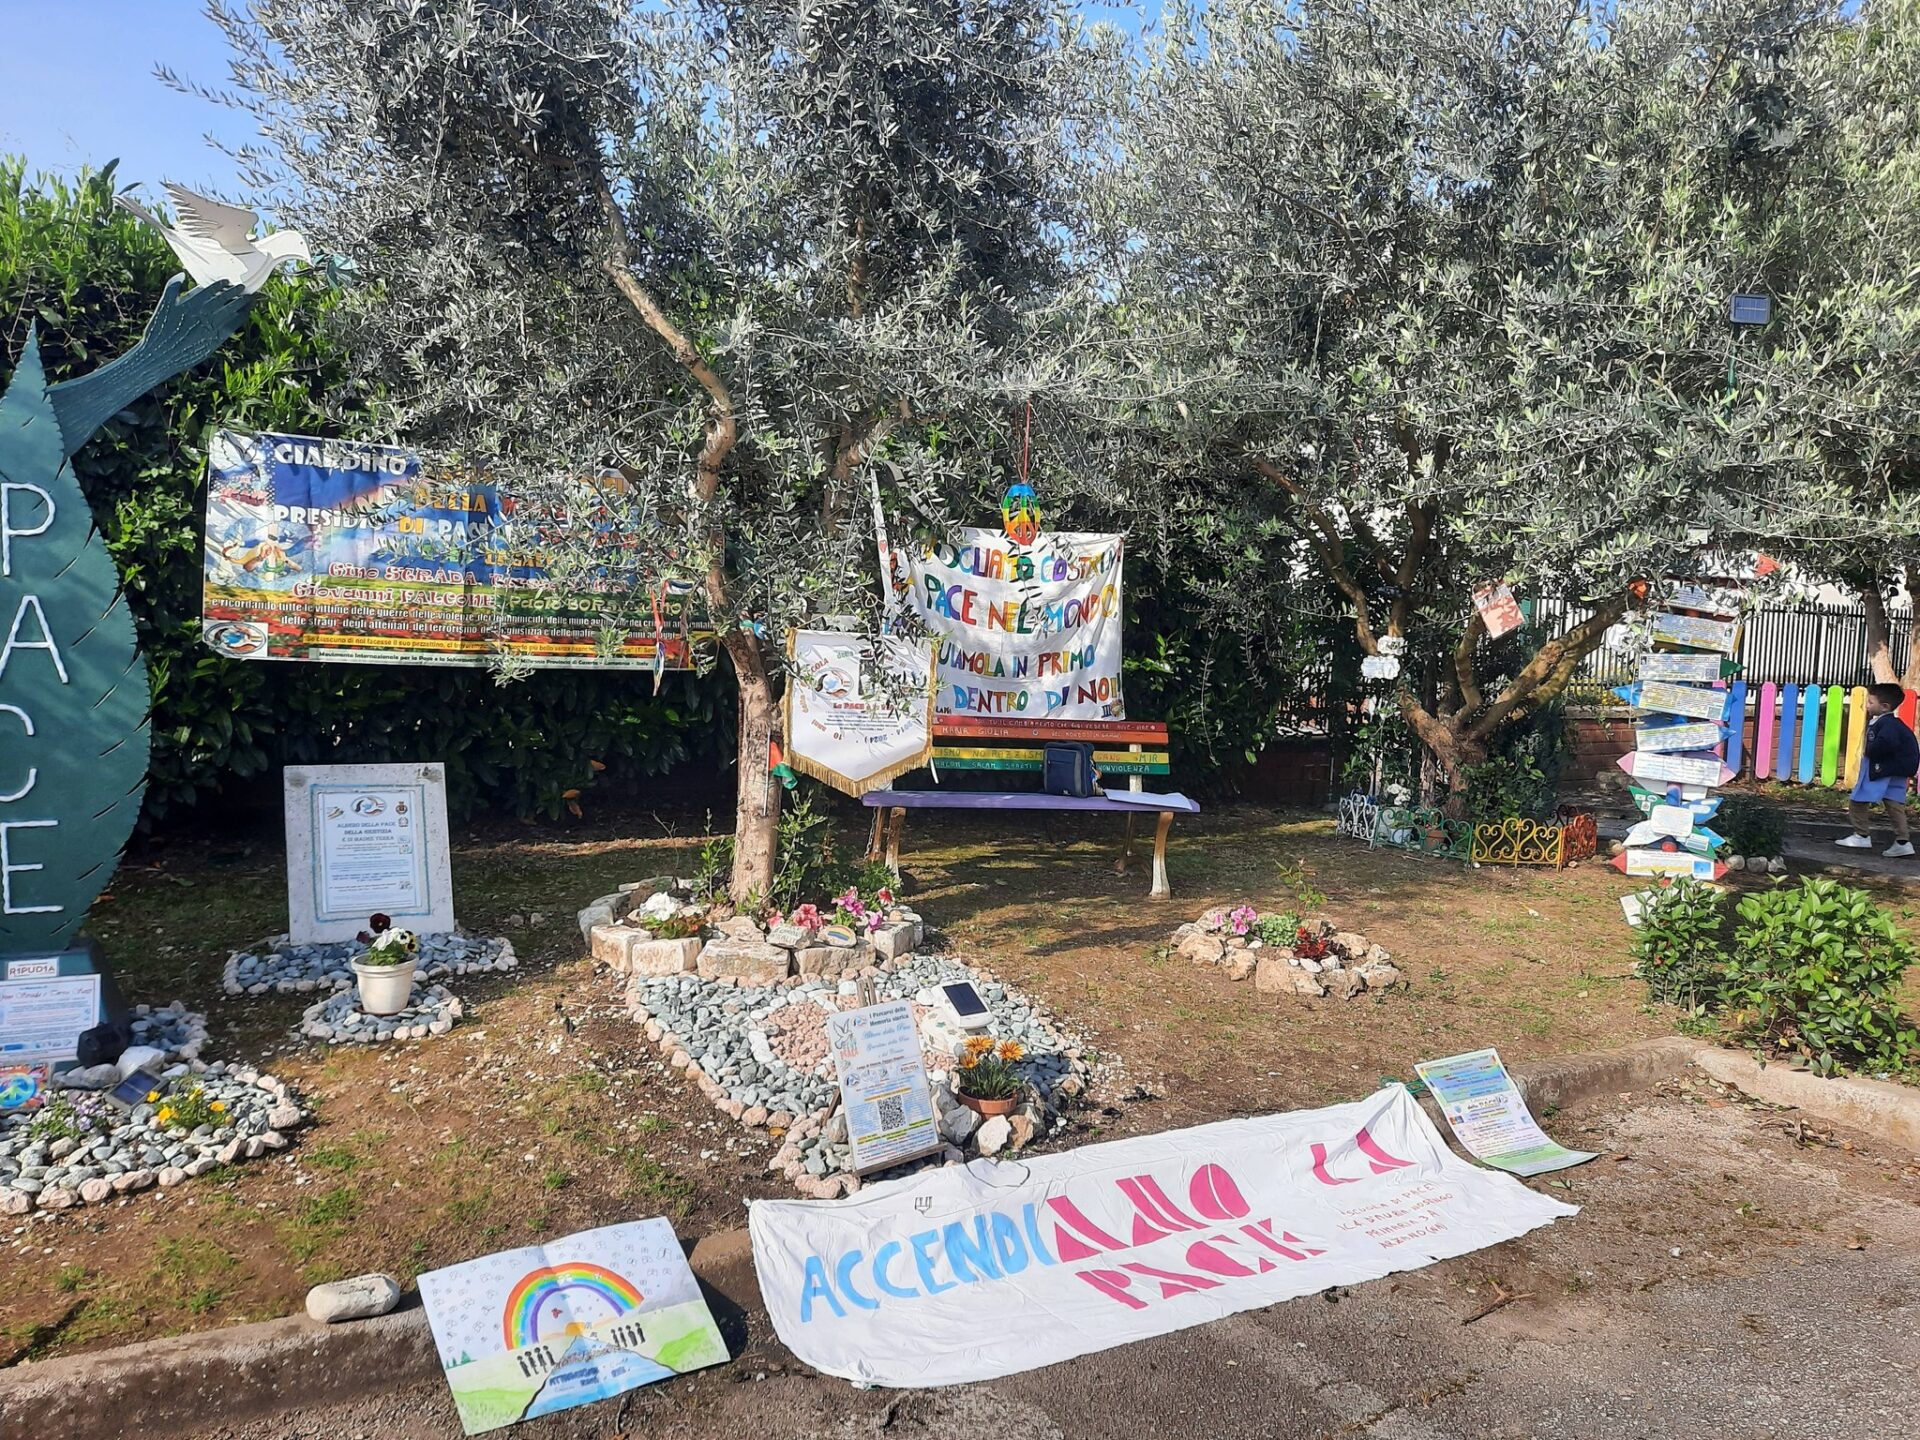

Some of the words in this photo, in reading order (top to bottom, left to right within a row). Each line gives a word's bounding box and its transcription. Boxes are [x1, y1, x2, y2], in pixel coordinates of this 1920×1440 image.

[275, 443, 407, 476] GIARDINO
[399, 516, 424, 535] DI
[328, 563, 379, 582] Gino
[292, 582, 393, 605] Giovanni
[220, 598, 276, 611] ricordando
[925, 573, 978, 626] PACE
[988, 598, 1035, 635] NEL
[1012, 655, 1028, 678] IN
[1037, 644, 1095, 677] PRIMO
[843, 702, 865, 710] PACE
[953, 684, 1029, 713] DENTRO
[1045, 685, 1070, 710] DI
[978, 727, 1009, 736] GIULIA
[972, 748, 986, 757] NO
[972, 760, 997, 769] SALAM
[1075, 1218, 1327, 1310] PACE
